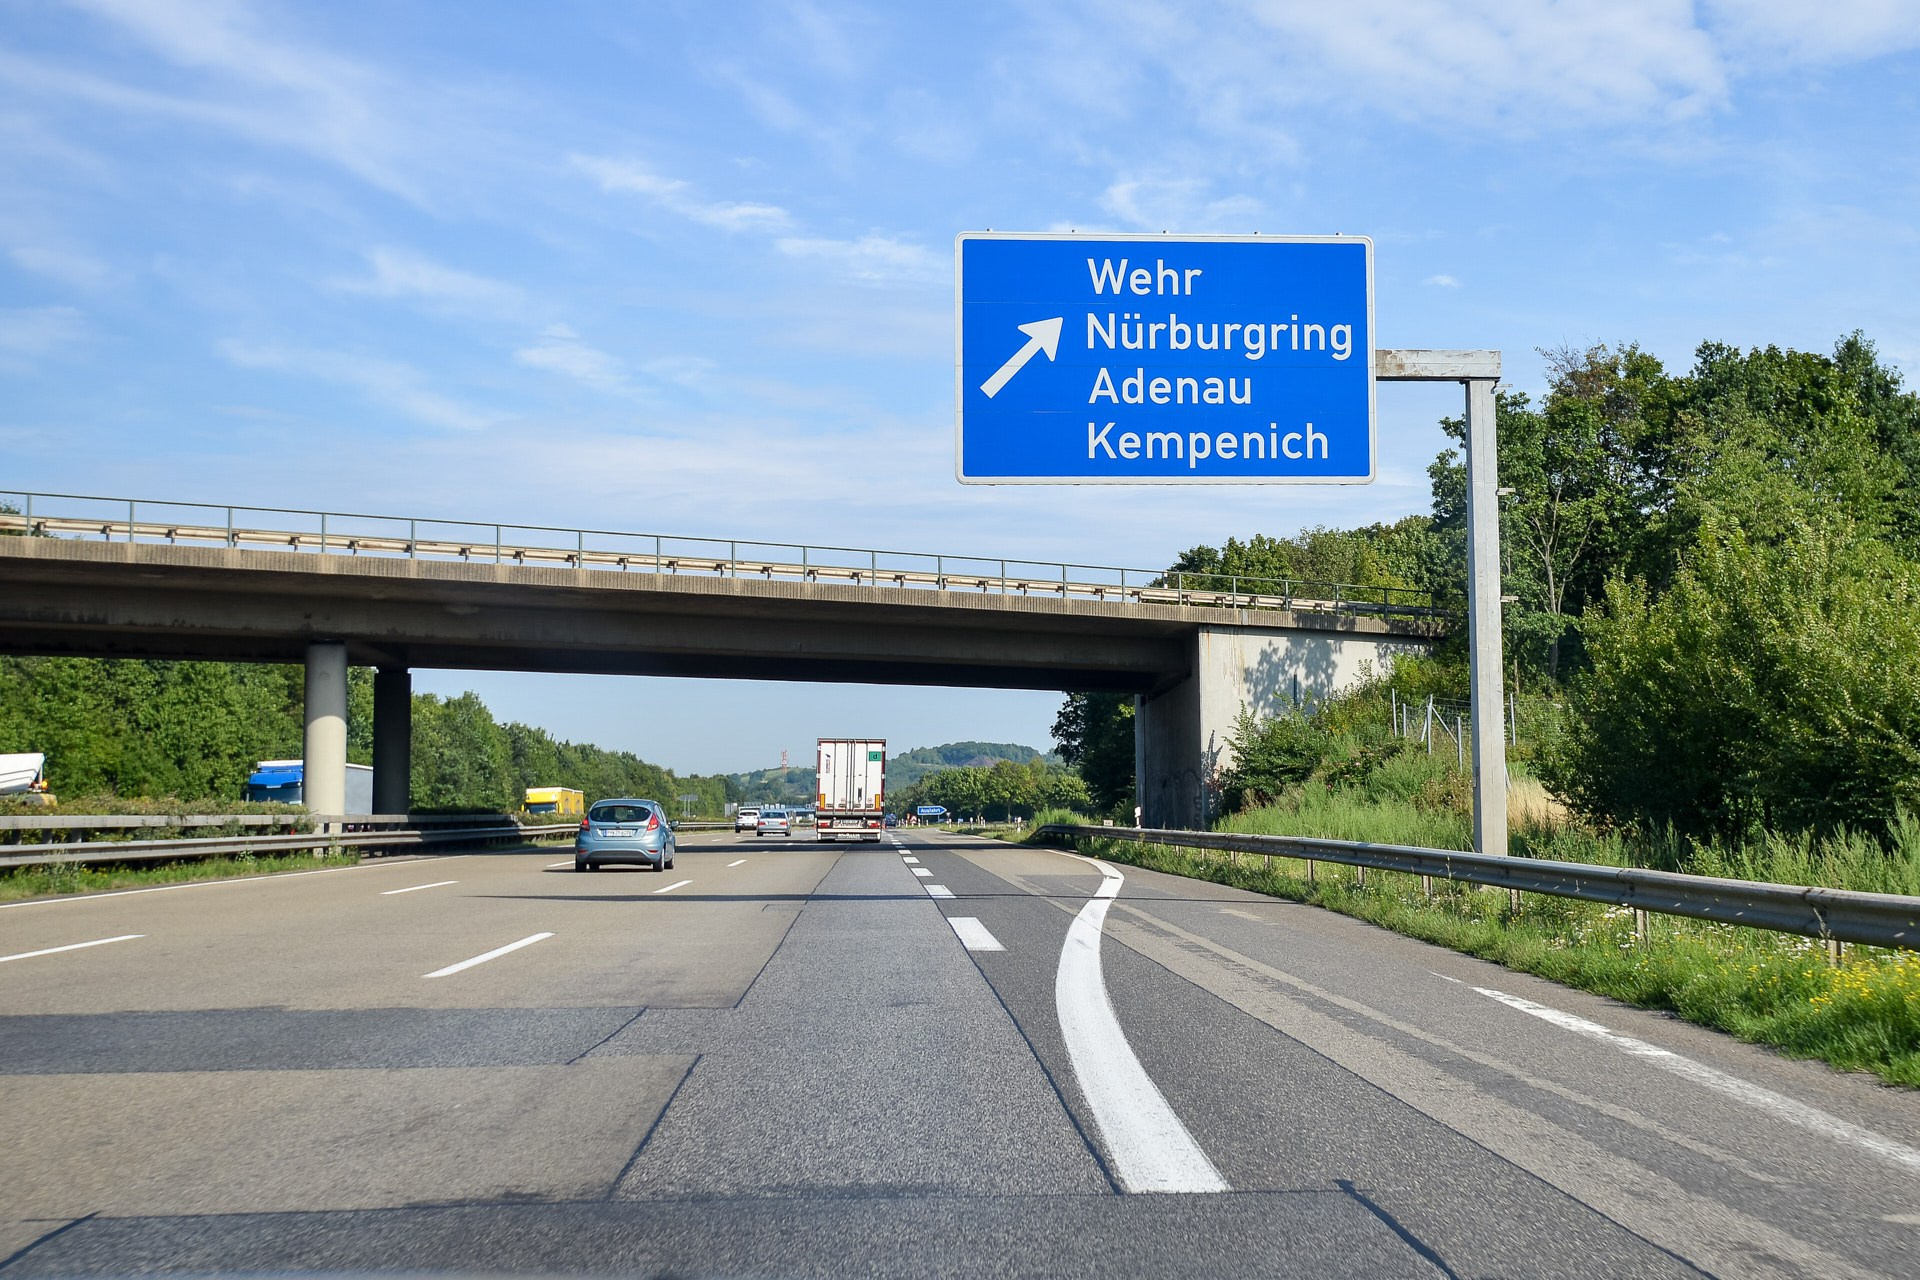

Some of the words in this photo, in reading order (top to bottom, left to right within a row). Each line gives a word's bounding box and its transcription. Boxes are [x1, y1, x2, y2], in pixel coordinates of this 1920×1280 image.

[1087, 258, 1203, 296] Wehr
[1087, 312, 1352, 361] Nürburgring
[1088, 367, 1251, 405] Adenau
[1088, 422, 1329, 469] Kempenich
